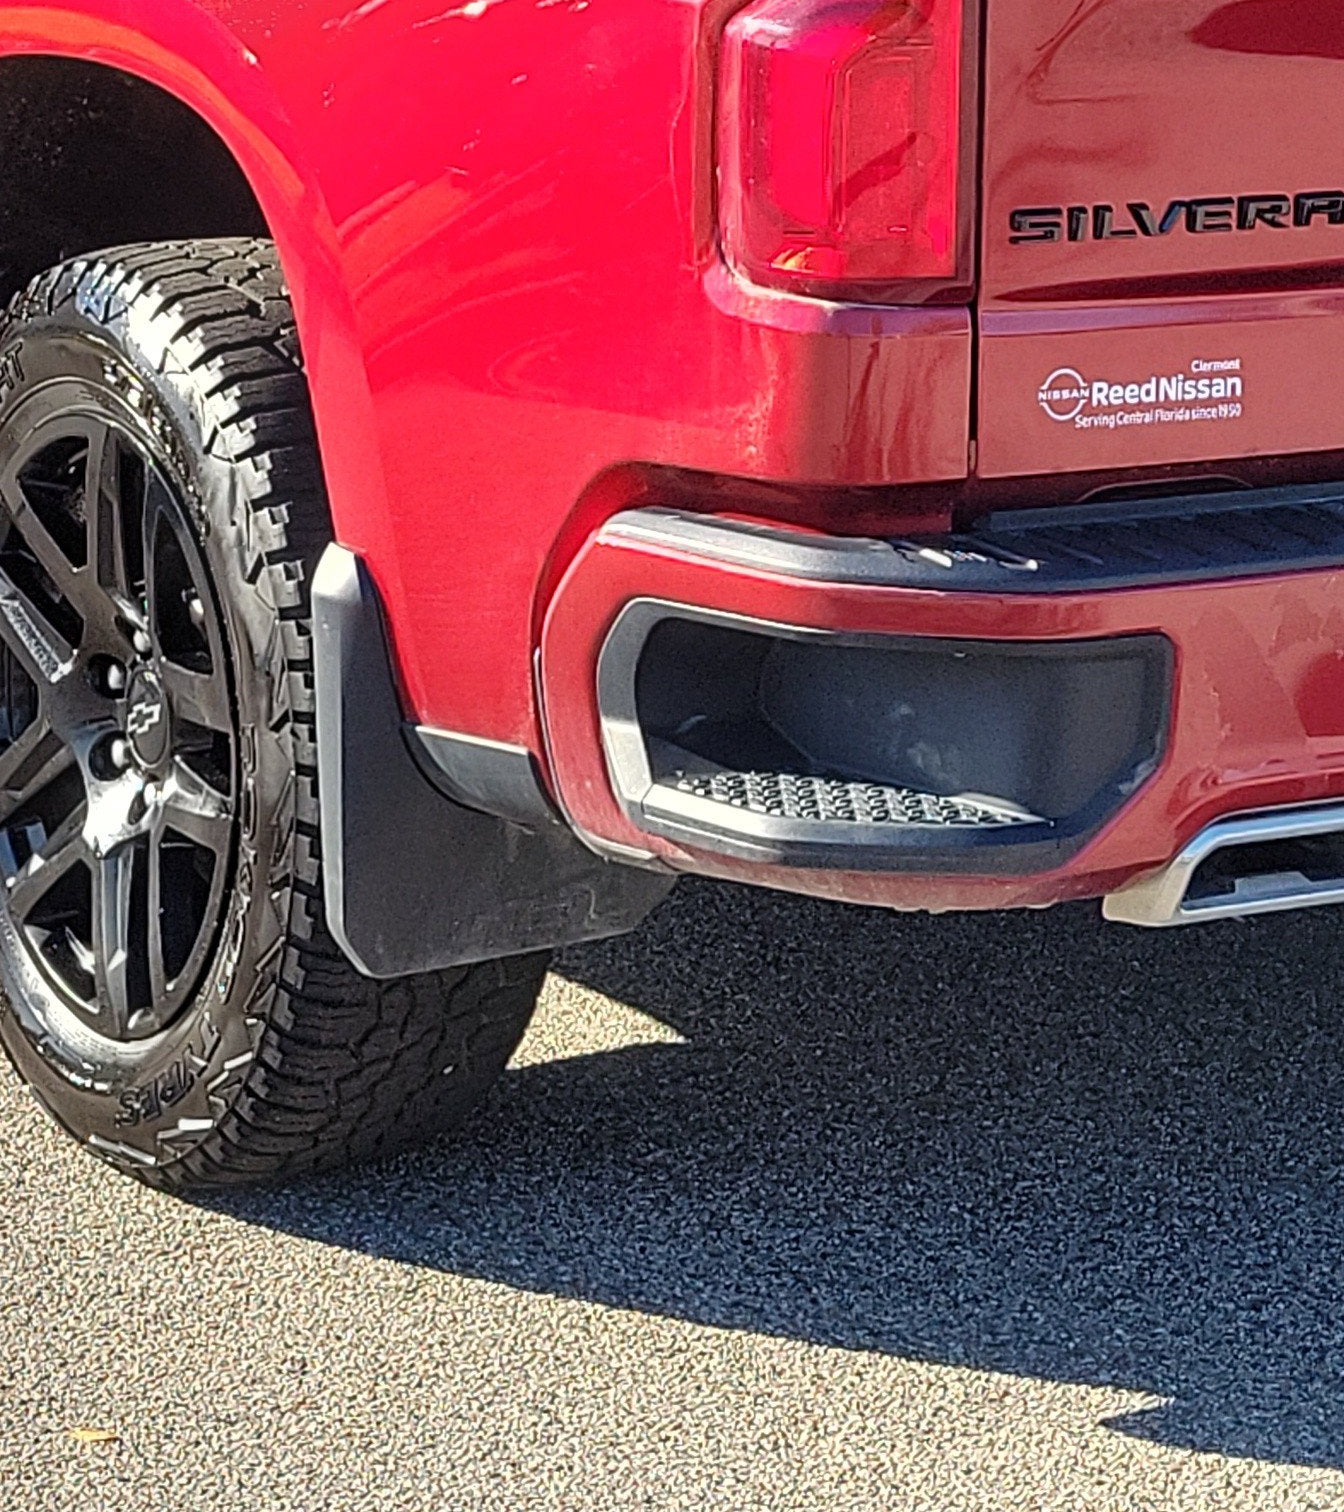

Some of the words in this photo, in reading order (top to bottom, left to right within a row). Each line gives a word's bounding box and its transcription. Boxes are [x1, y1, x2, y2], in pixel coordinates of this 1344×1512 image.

[1037, 388, 1090, 401] NISSAN
[1074, 413, 1116, 429] Serving
[1116, 409, 1154, 426] Central
[1155, 407, 1191, 424] Florida
